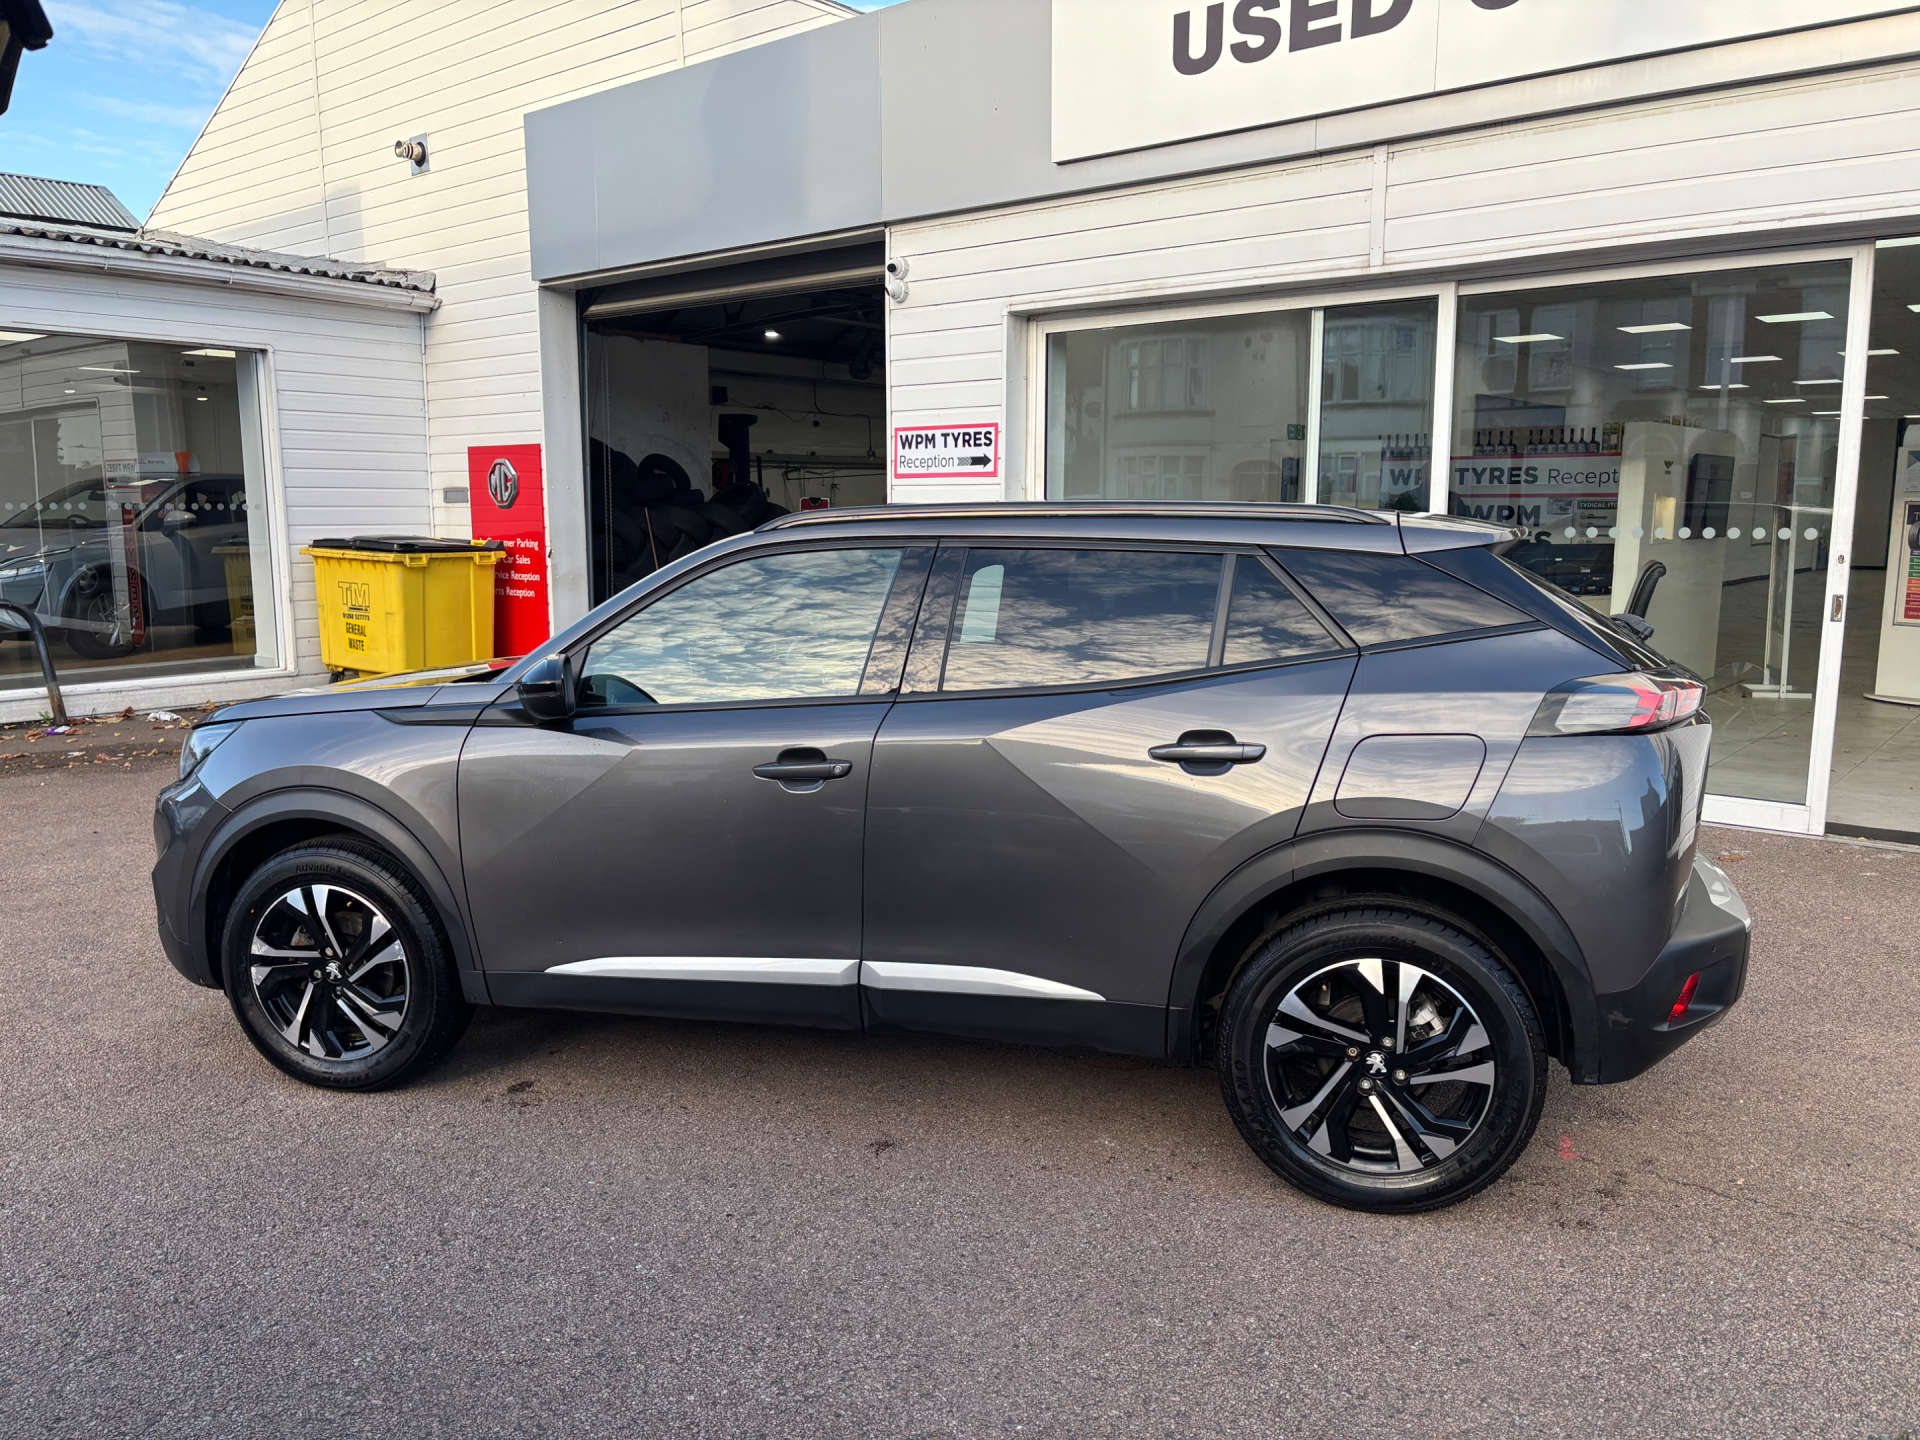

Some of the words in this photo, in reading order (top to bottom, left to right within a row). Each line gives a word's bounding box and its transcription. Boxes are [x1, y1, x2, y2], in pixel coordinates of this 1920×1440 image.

[1172, 0, 1414, 76] USED
[899, 433, 937, 450] WPM
[940, 431, 993, 448] TYRES
[899, 455, 955, 471] Reception
[489, 462, 516, 505] MG
[1454, 466, 1539, 486] TYRES
[516, 537, 539, 551] Parking
[515, 554, 531, 565] Sales
[510, 570, 541, 583] Reception
[505, 586, 535, 598] Reception
[345, 621, 367, 637] GENERAL
[347, 637, 365, 652] WASTE
